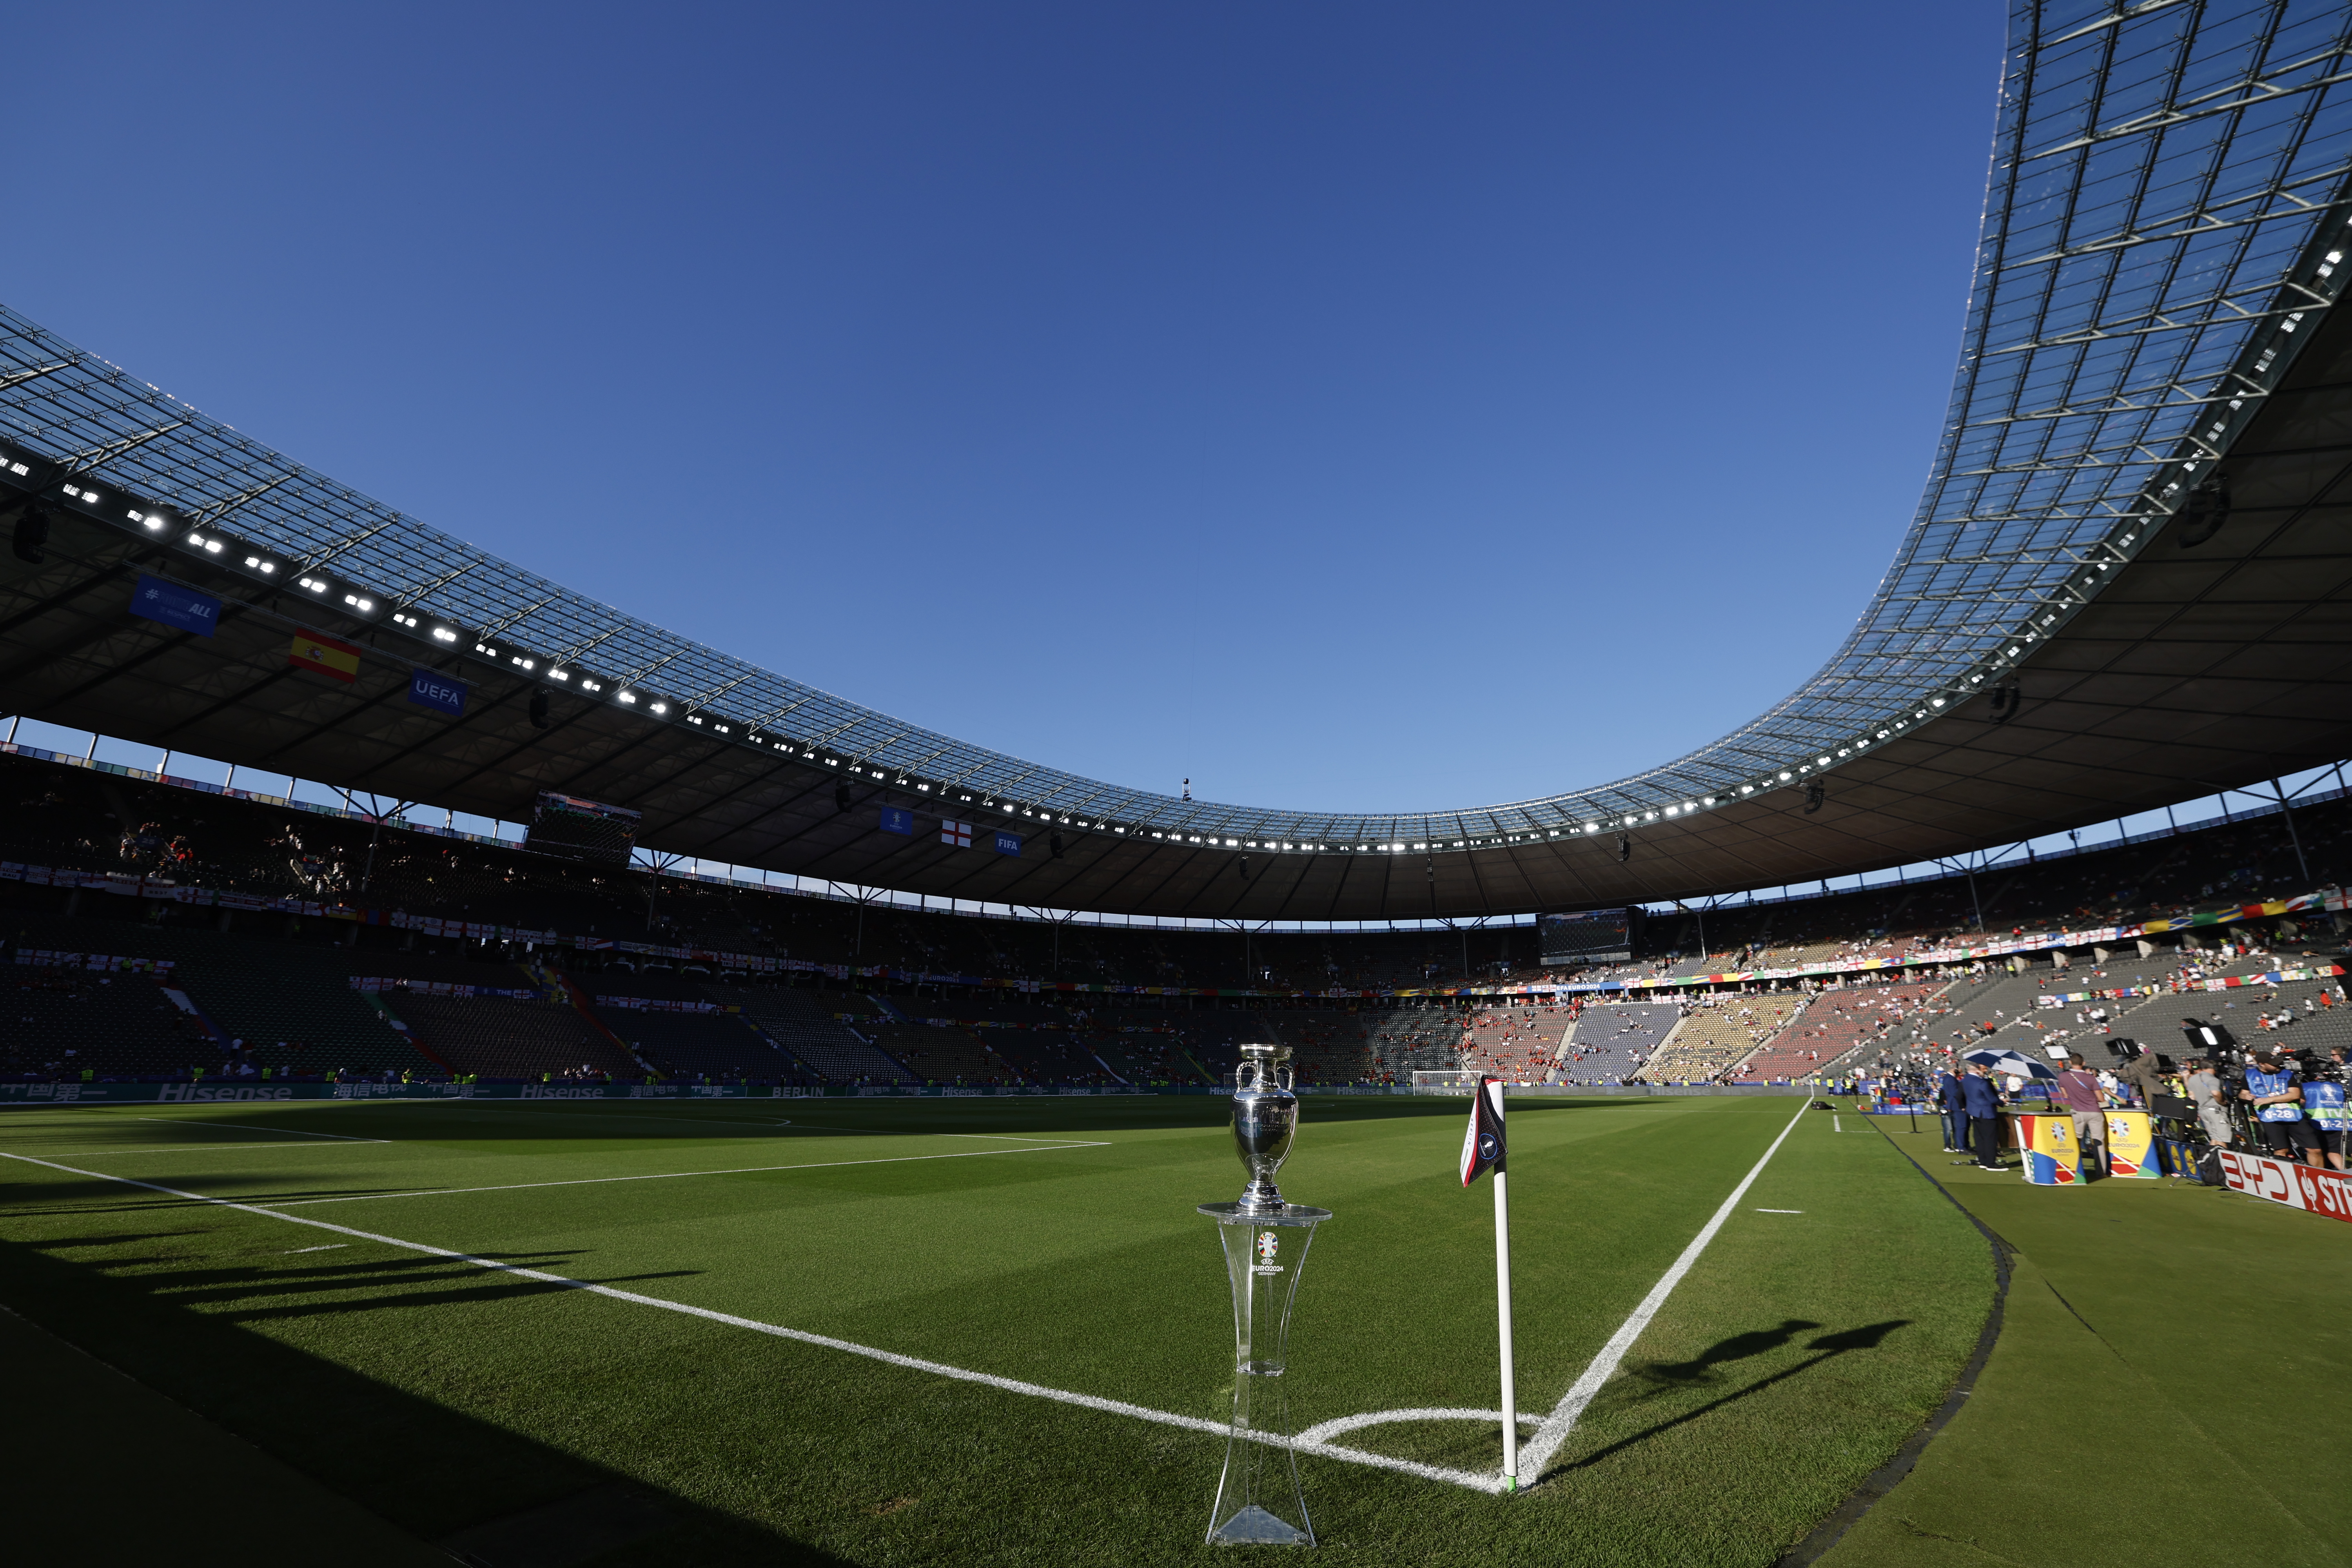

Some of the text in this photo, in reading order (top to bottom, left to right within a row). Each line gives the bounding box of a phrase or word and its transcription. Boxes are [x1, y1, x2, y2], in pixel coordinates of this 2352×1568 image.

[416, 680, 459, 705] UEFA
[998, 838, 1017, 850] FIFA
[158, 1083, 292, 1100] Hisense
[520, 1085, 604, 1098] Hisense
[773, 1087, 824, 1097] BERLIN
[942, 1087, 982, 1096] Hisense
[1650, 1086, 1711, 1096] Hisense
[2326, 1109, 2344, 1117] TV
[2221, 1152, 2288, 1201] BYD
